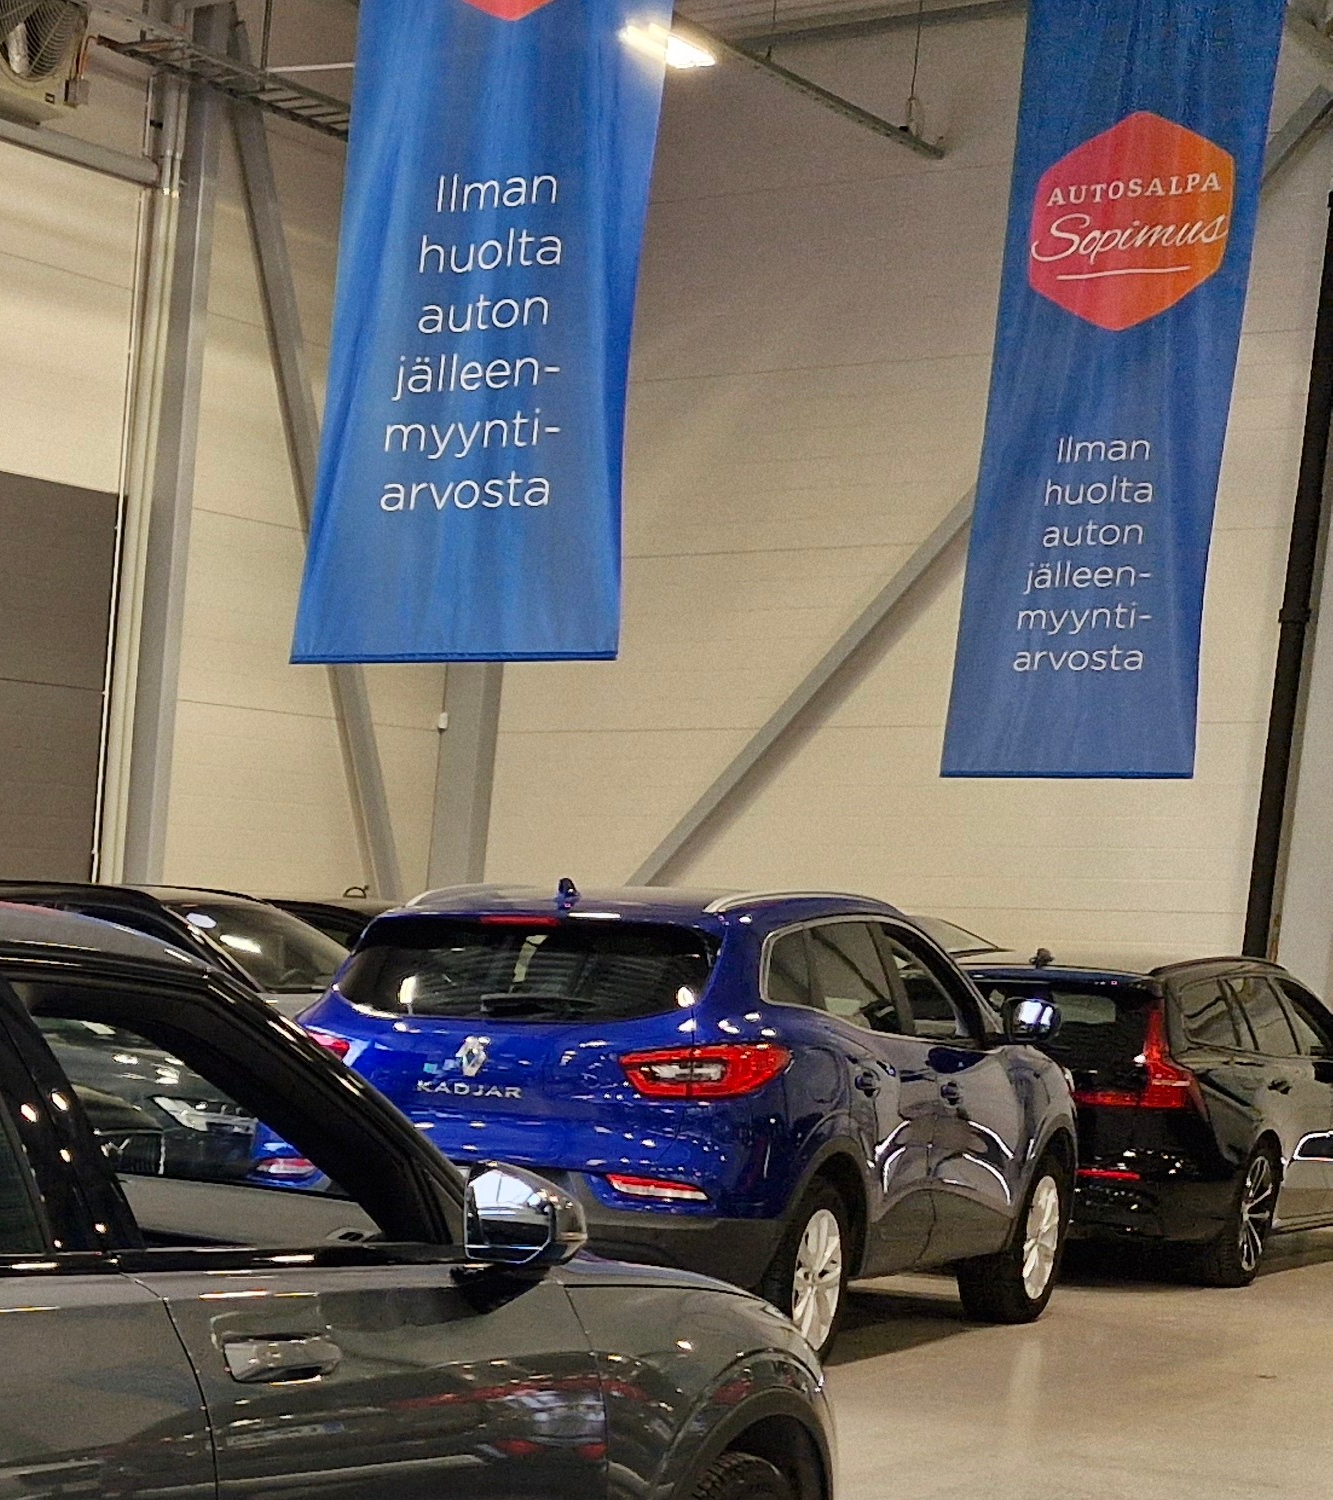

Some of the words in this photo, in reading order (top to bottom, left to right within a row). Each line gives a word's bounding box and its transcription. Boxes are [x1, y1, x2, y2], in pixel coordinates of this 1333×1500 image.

[436, 173, 559, 213] Ilman
[1047, 171, 1222, 207] AUTOSALPA
[418, 228, 564, 274] huolta
[1030, 212, 1229, 265] Sopimus
[417, 294, 549, 335] auton
[391, 352, 562, 402] jälleen-
[384, 407, 562, 460] myynti-
[1056, 434, 1151, 464] Ilman
[380, 469, 551, 513] arvosta
[1043, 474, 1154, 506] huolta
[1042, 519, 1144, 547] auton
[1023, 560, 1152, 595] jälleen-
[1016, 600, 1153, 636] myynti-
[1012, 644, 1145, 672] arvosta
[416, 1079, 523, 1099] KADJAR
